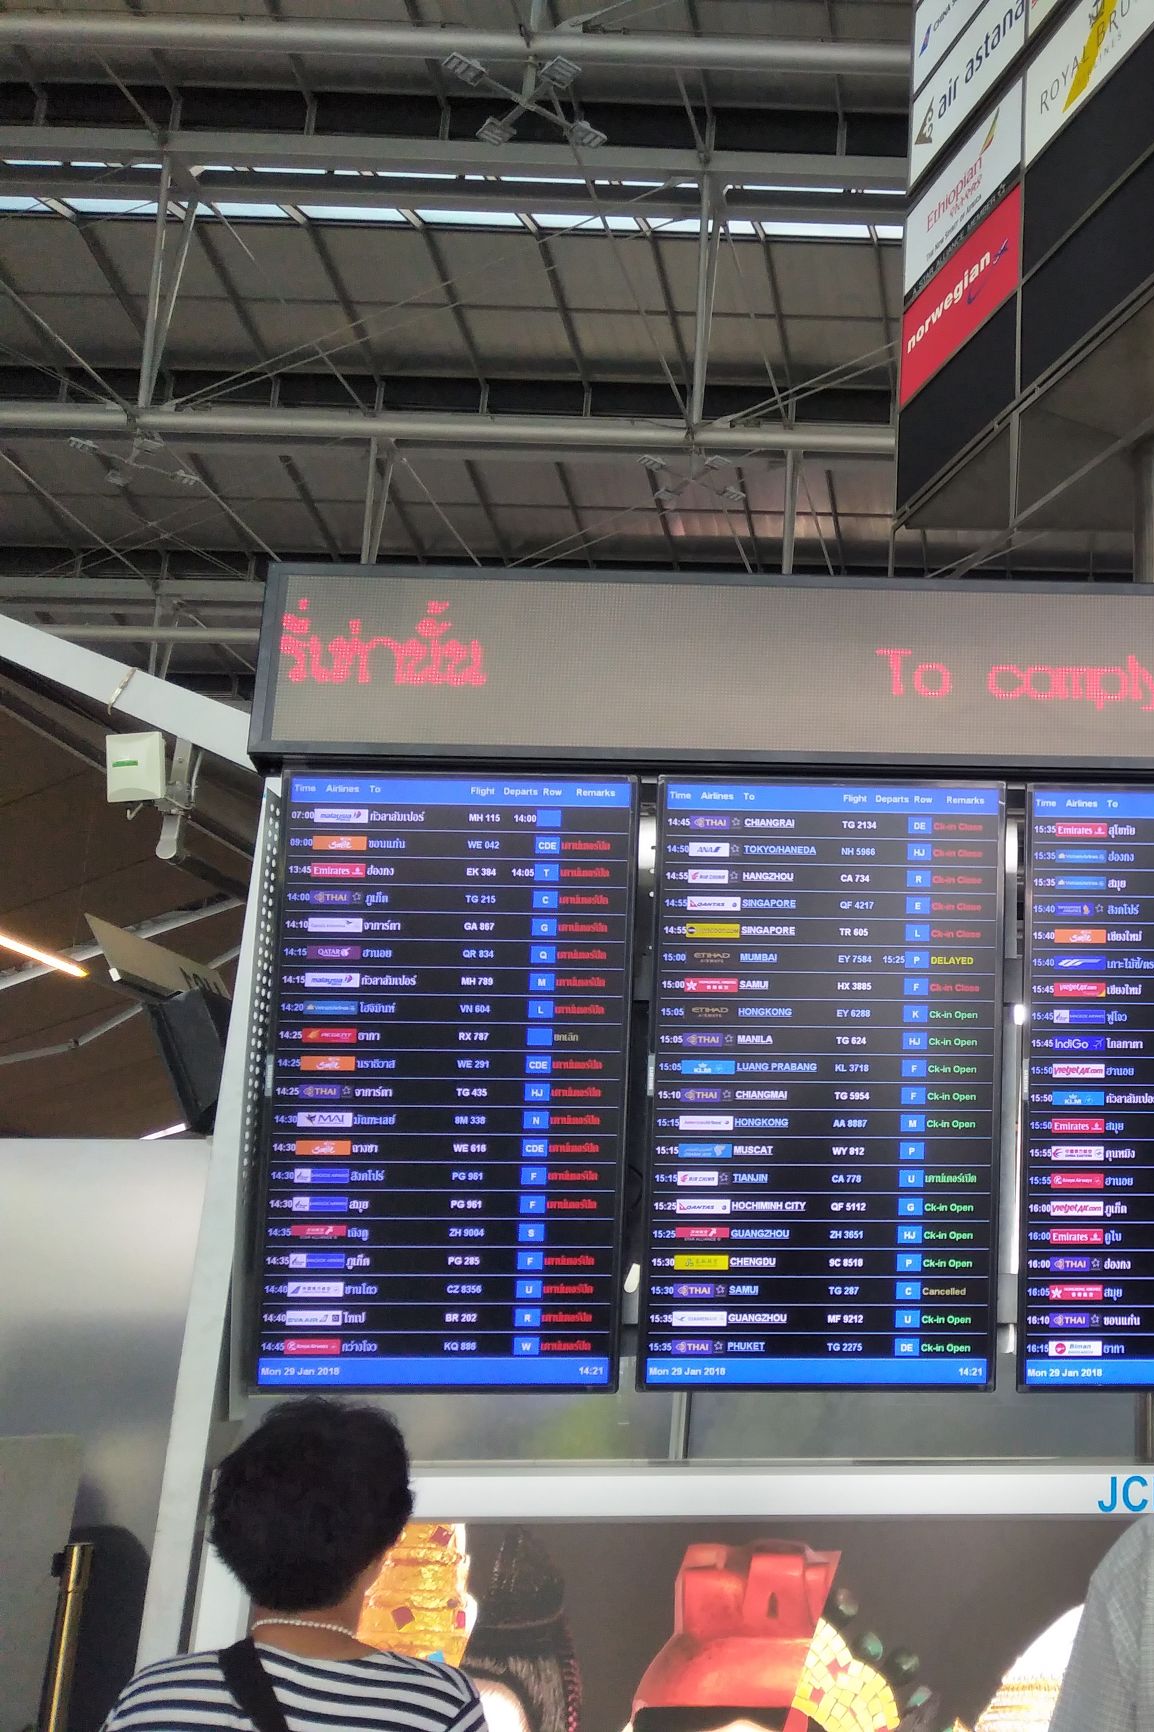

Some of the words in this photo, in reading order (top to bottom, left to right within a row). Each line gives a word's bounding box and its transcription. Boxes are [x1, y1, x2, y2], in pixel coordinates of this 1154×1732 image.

[938, 76, 959, 119] air
[965, 0, 1024, 83] astana
[1040, 46, 1088, 114] ROYAL
[927, 157, 983, 233] Ethiopian
[907, 251, 991, 353] norwegian
[875, 648, 952, 697] To
[294, 784, 316, 792] Time
[326, 784, 359, 793] Airlines
[370, 785, 381, 793] To
[471, 787, 495, 797] Flight
[504, 787, 538, 798] Departs
[543, 788, 562, 797] Row
[576, 789, 615, 798] Remarks
[292, 811, 314, 820] 07:00
[469, 813, 483, 823] MH
[485, 813, 500, 823] 115
[667, 818, 690, 827] 14:45
[744, 819, 795, 828] CHIANGRAI
[842, 821, 856, 829] TG
[857, 821, 877, 829] 2134
[1058, 826, 1093, 835] Emirates
[290, 838, 313, 847] 09:00
[467, 840, 483, 850] WE
[485, 840, 500, 850] 042
[744, 846, 816, 855] TOKYO/HANEDA
[288, 865, 311, 874] 13:45
[313, 866, 350, 875] Emirates
[466, 868, 480, 877] EK
[481, 868, 496, 877] 384
[743, 872, 794, 882] HANGZHOU
[840, 874, 854, 883] CA
[856, 874, 870, 883] 734
[287, 892, 310, 901] 14:00
[465, 895, 479, 904] TG
[480, 895, 496, 904] 215
[665, 899, 687, 907] 14:55
[742, 899, 796, 909] SINGAPORE
[840, 901, 854, 910] QF
[855, 901, 874, 910] 4217
[464, 922, 478, 931] GA
[741, 926, 795, 936] SINGAPORE
[839, 928, 852, 937] TR
[854, 928, 868, 937] 605
[462, 949, 477, 959] QR
[479, 949, 494, 958] 834
[663, 954, 686, 962] 15:00
[740, 954, 777, 962] MUMBAI
[838, 955, 851, 964] EY
[852, 955, 872, 964] 7584
[931, 956, 974, 965] DELAYED
[461, 977, 476, 986] MH
[478, 977, 493, 986] 789
[739, 981, 768, 990] SAMUI
[837, 982, 850, 991] HX
[852, 982, 872, 991] 3885
[460, 1004, 474, 1013] VN
[476, 1004, 490, 1014] 604
[738, 1008, 792, 1017] HONGKONG
[837, 1009, 849, 1018] EY
[851, 1009, 870, 1018] 6288
[929, 1010, 951, 1019] Ck-in
[953, 1010, 978, 1021] Open
[459, 1032, 473, 1041] RX
[474, 1032, 489, 1041] 787
[737, 1035, 773, 1044] MANILA
[836, 1036, 849, 1045] TG
[851, 1036, 867, 1045] 624
[1054, 1038, 1089, 1049] IndiGo
[457, 1059, 473, 1069] WE
[474, 1059, 489, 1069] 291
[737, 1063, 770, 1071] LUANG
[771, 1063, 817, 1072] PRABANG
[835, 1063, 847, 1072] KL
[849, 1064, 869, 1072] 3718
[735, 1090, 787, 1100] CHIANGMAI
[835, 1091, 848, 1100] TG
[849, 1092, 870, 1100] 5954
[734, 1119, 789, 1128] HONGKONG
[734, 1146, 773, 1155] MUSCAT
[733, 1174, 768, 1183] TIANJIN
[832, 1175, 845, 1183] CA
[847, 1175, 862, 1183] 778
[732, 1202, 784, 1211] HOCHIMINH
[785, 1202, 806, 1211] CITY
[831, 1202, 845, 1212] QF
[846, 1202, 866, 1212] 5112
[731, 1230, 790, 1239] GUANGZHOU
[730, 1257, 776, 1267] CHENGDU
[729, 1286, 758, 1295] SAMUI
[829, 1286, 842, 1295] TG
[843, 1286, 859, 1295] 287
[922, 1287, 966, 1296] Cancelled
[728, 1314, 787, 1324] GUANGZHOU
[727, 1342, 765, 1352] PHUKET
[827, 1343, 841, 1352] TG
[842, 1343, 863, 1352] 2275
[261, 1366, 281, 1376] Mon
[283, 1367, 295, 1376] 29
[297, 1367, 315, 1376] Jan
[317, 1367, 339, 1376] 2018
[579, 1366, 604, 1376] 14:21
